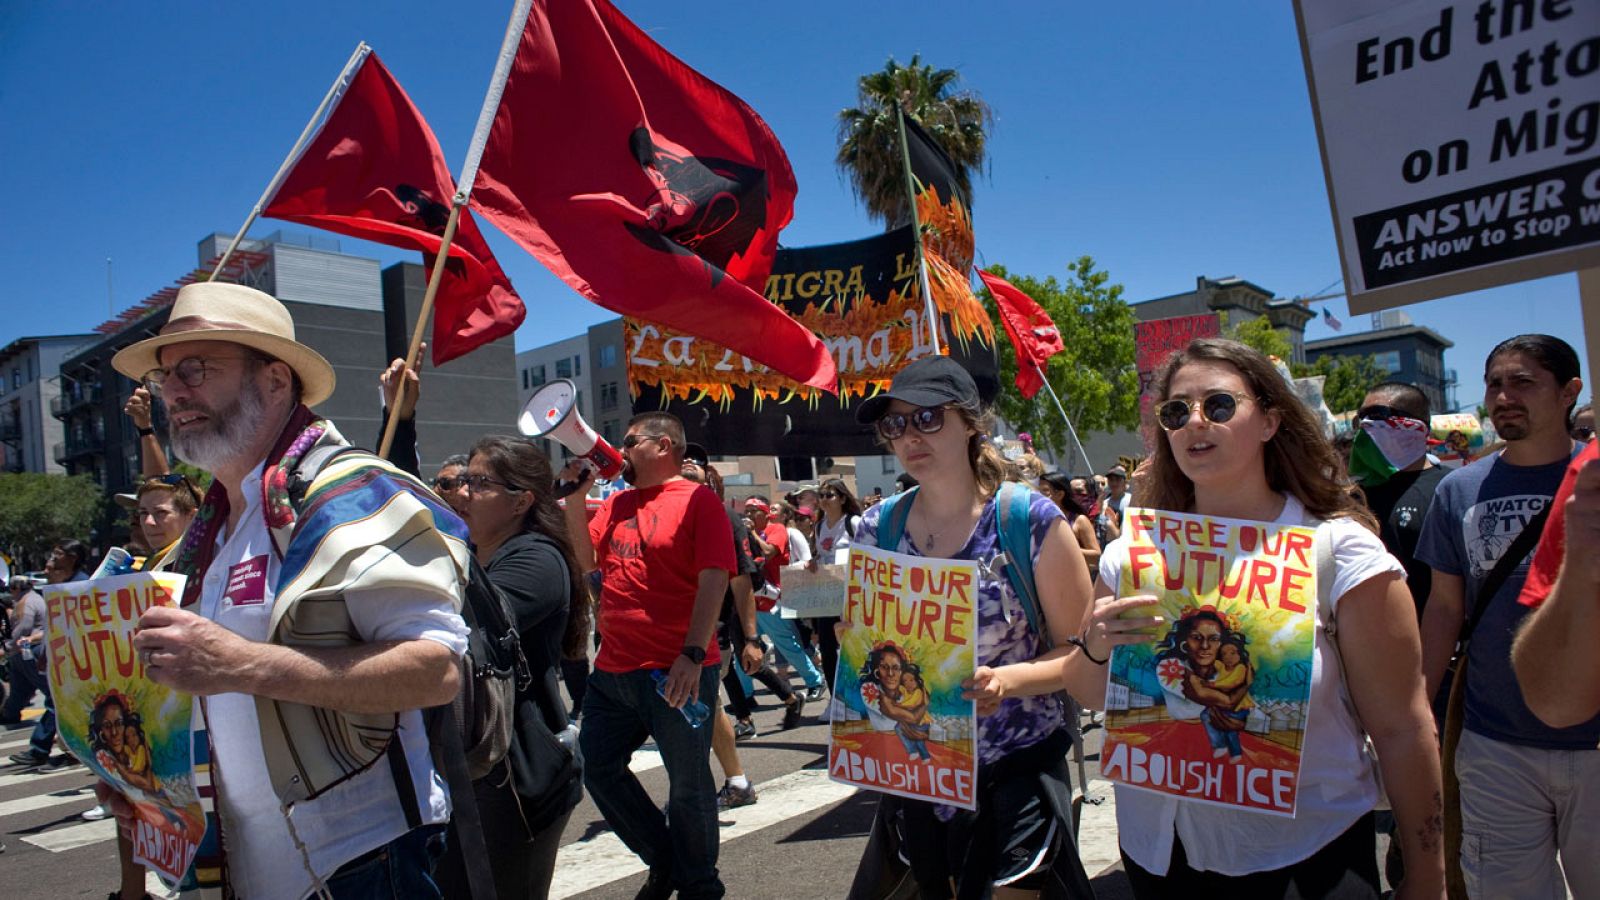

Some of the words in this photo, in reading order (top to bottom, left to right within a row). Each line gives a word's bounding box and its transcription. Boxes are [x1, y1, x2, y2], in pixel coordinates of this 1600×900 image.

[1356, 7, 1453, 84] End
[1474, 0, 1573, 45] the
[1402, 139, 1469, 184] on
[1489, 98, 1600, 163] Mig
[1373, 179, 1566, 249] ANSWER
[1378, 245, 1415, 270] Act
[1421, 234, 1474, 261] Now
[1481, 228, 1506, 247] to
[1513, 214, 1571, 240] Stop
[630, 325, 696, 367] La
[1239, 526, 1312, 568] OUR
[910, 567, 971, 604] OUR
[1129, 546, 1312, 614] FUTURE
[848, 586, 971, 645] FUTURE
[50, 627, 145, 686] FUTU
[832, 749, 919, 791] ABOLISH
[928, 765, 971, 800] ICE
[1103, 743, 1223, 798] ABOLISH
[1236, 764, 1294, 808] ICE
[136, 819, 183, 875] ABOLISH
